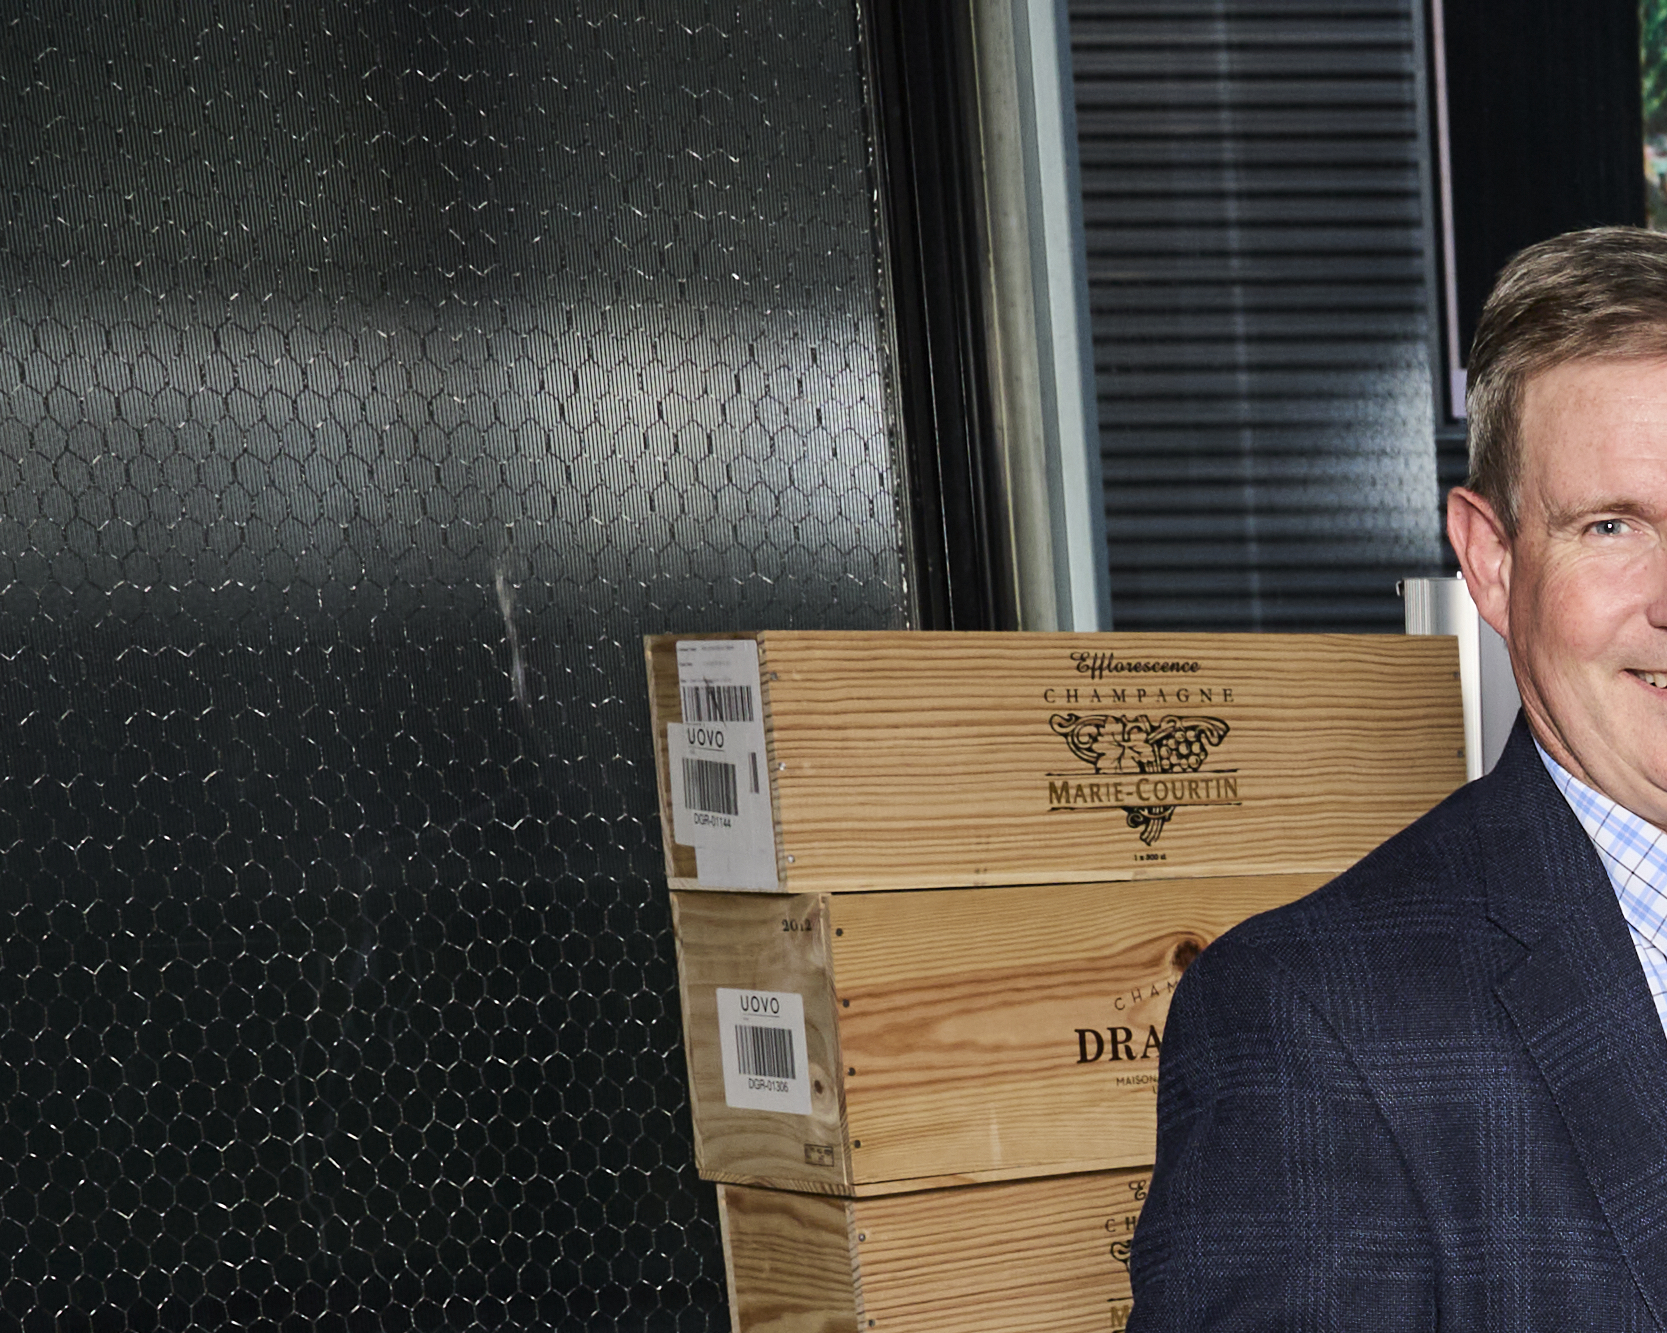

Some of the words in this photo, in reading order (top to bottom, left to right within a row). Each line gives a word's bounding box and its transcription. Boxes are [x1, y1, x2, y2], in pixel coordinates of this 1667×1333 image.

[1070, 652, 1200, 680] Efflorescence
[1044, 688, 1234, 703] CHAMPAGNE
[687, 727, 725, 748] UOVO
[1049, 777, 1238, 805] MARIE-COURTIN
[739, 995, 780, 1014] UOVO
